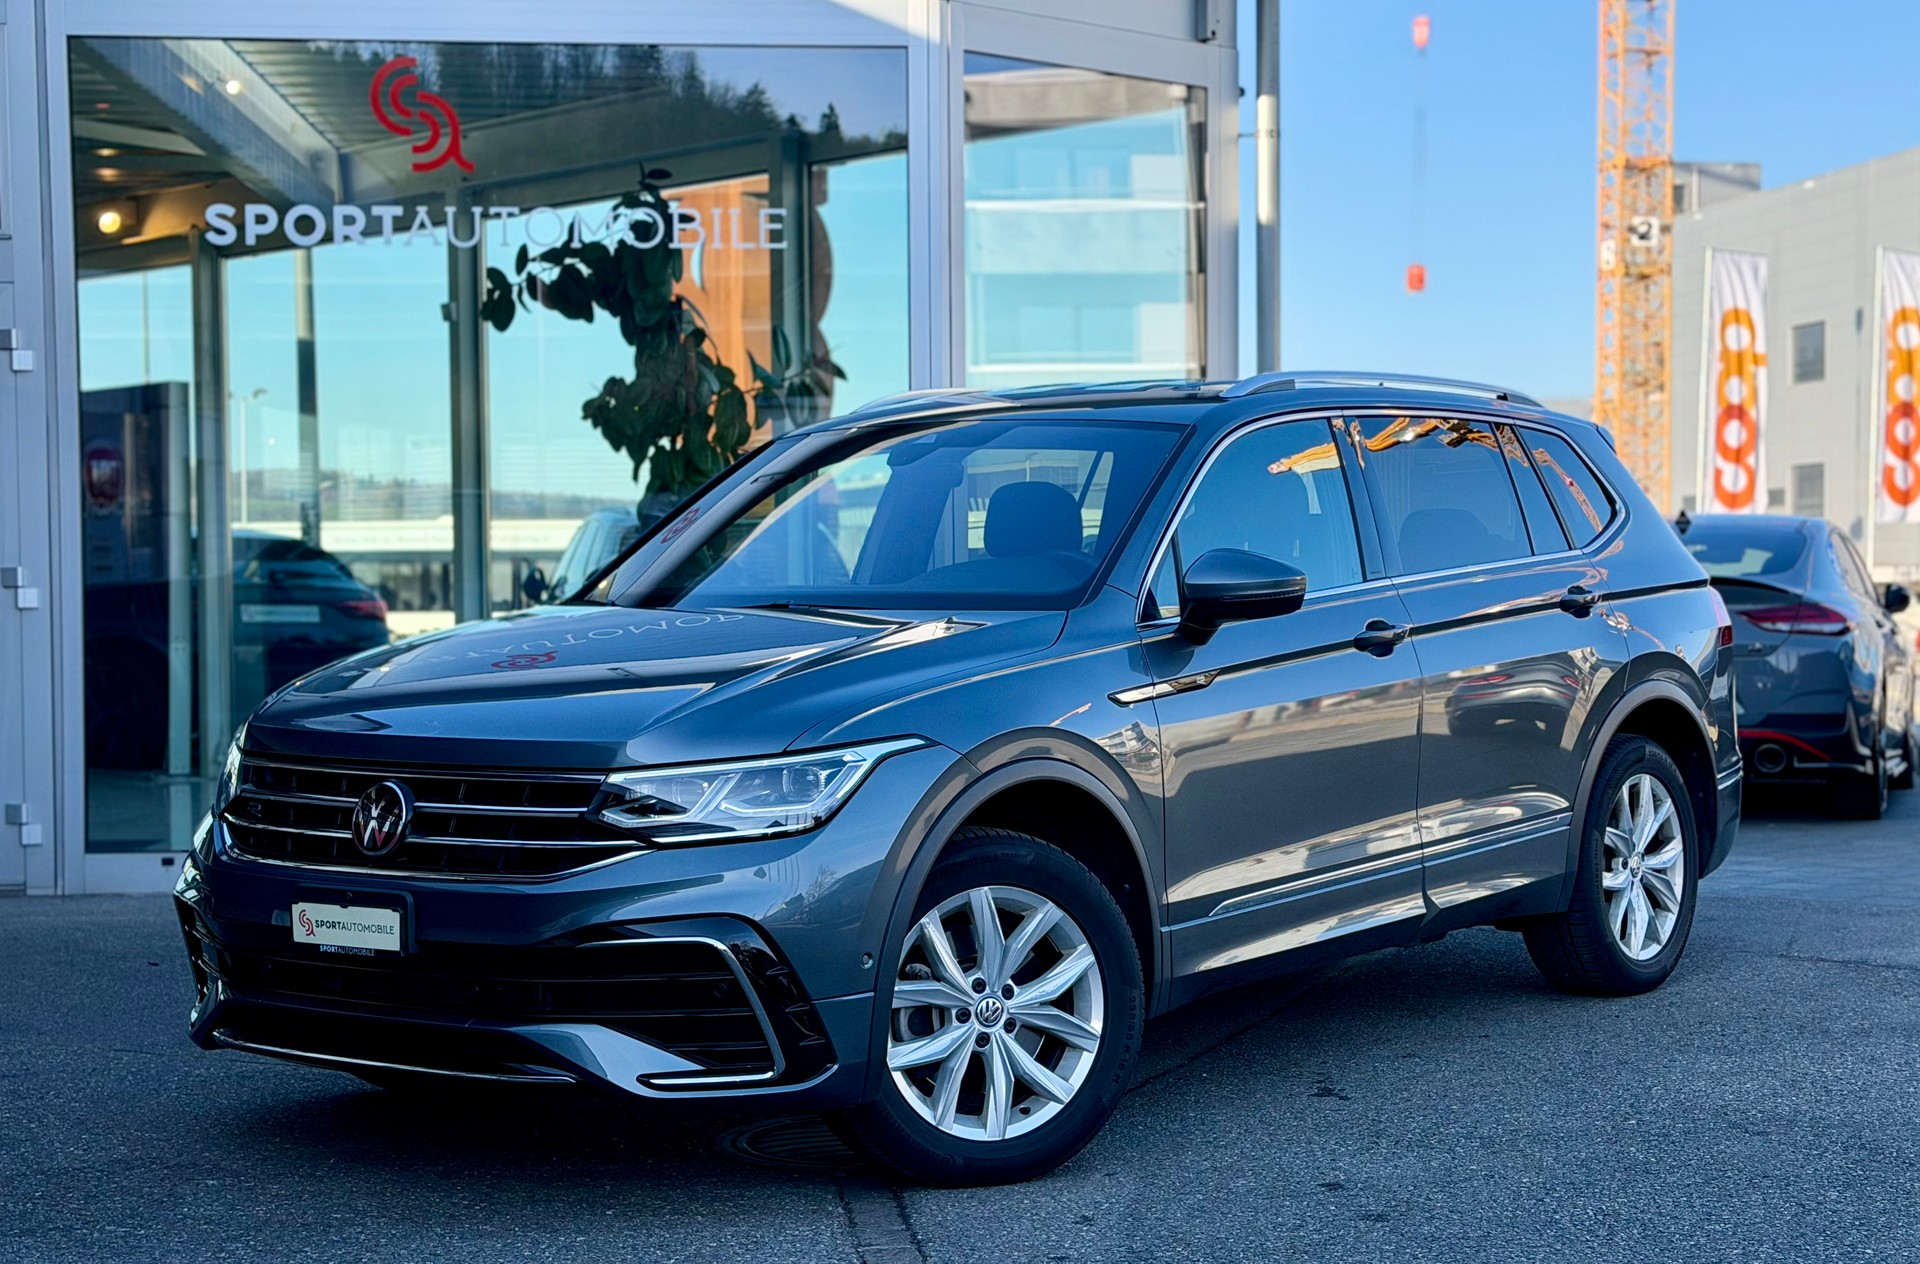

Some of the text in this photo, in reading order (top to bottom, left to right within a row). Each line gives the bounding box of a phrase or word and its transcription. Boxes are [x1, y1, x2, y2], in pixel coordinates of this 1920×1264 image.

[204, 202, 788, 250] SPORTAUTOMOBILE
[1714, 306, 1768, 511] coop
[315, 919, 395, 935] SPORTAUTOMOBILE
[319, 945, 375, 957] SPORTAUTOMOBILE
[976, 996, 1004, 1027] VW
